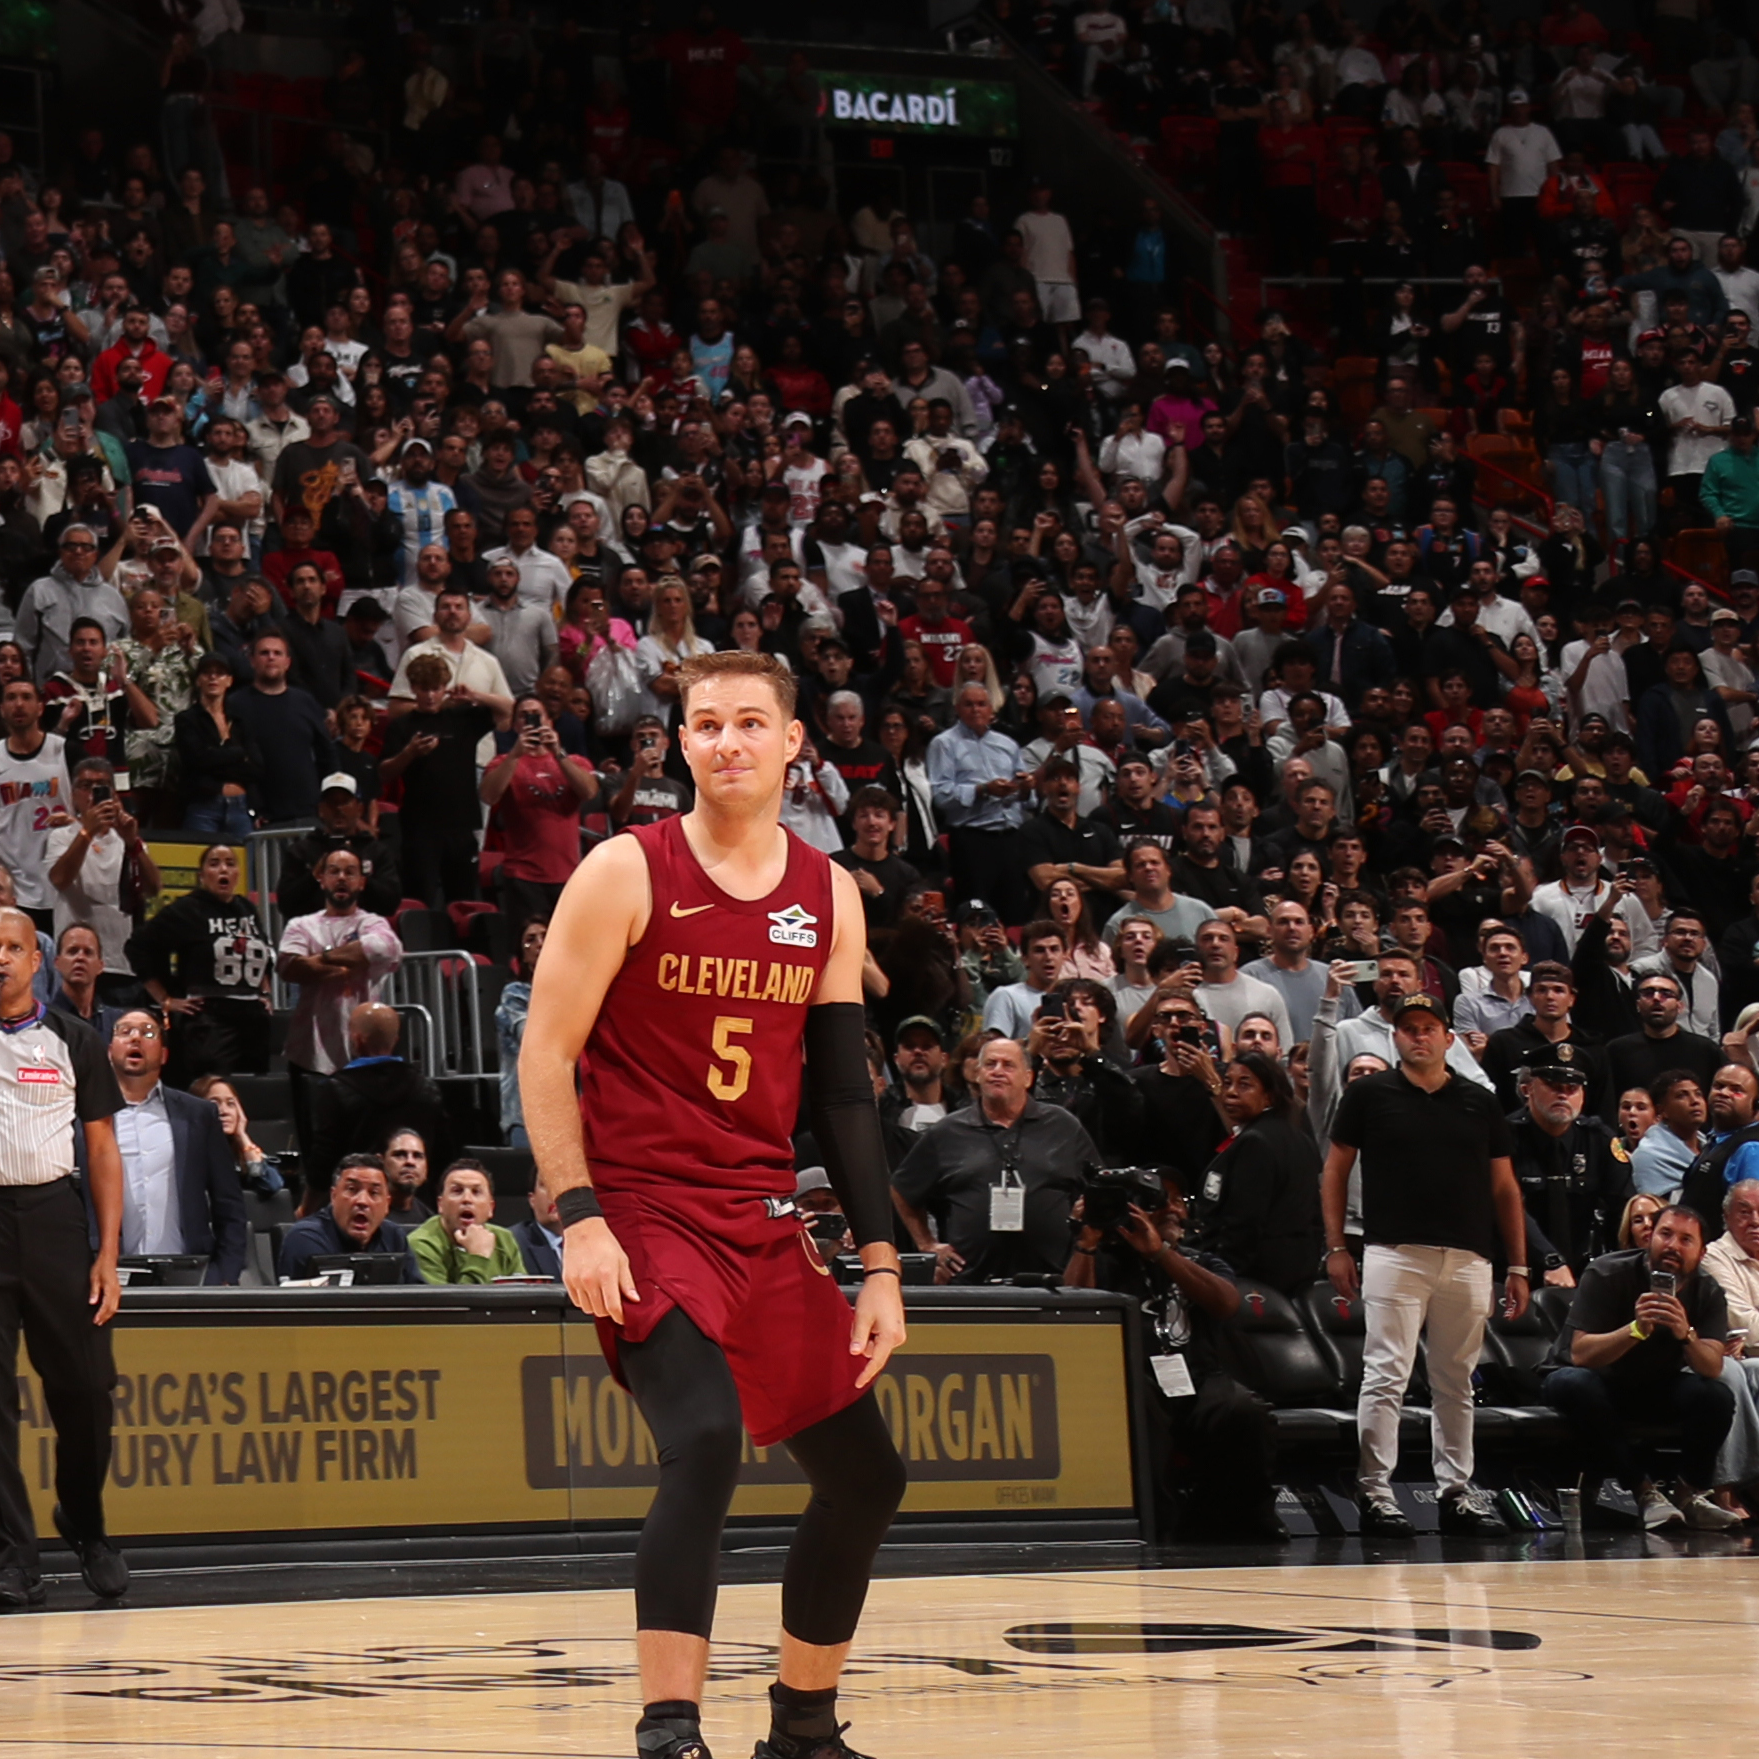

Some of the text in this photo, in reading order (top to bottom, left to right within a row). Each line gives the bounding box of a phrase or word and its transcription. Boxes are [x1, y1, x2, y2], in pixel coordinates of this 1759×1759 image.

[833, 87, 960, 127] BACARDÍ
[213, 936, 270, 989] 88
[771, 928, 815, 945] CLIFFS
[657, 952, 816, 1005] CLEVELAND
[20, 1070, 57, 1082] Emirates
[706, 1016, 754, 1103] 5
[259, 1369, 440, 1425] LARGEST
[874, 1371, 1035, 1463] ORGAN
[39, 1427, 418, 1490] IURY LAW FIRM
